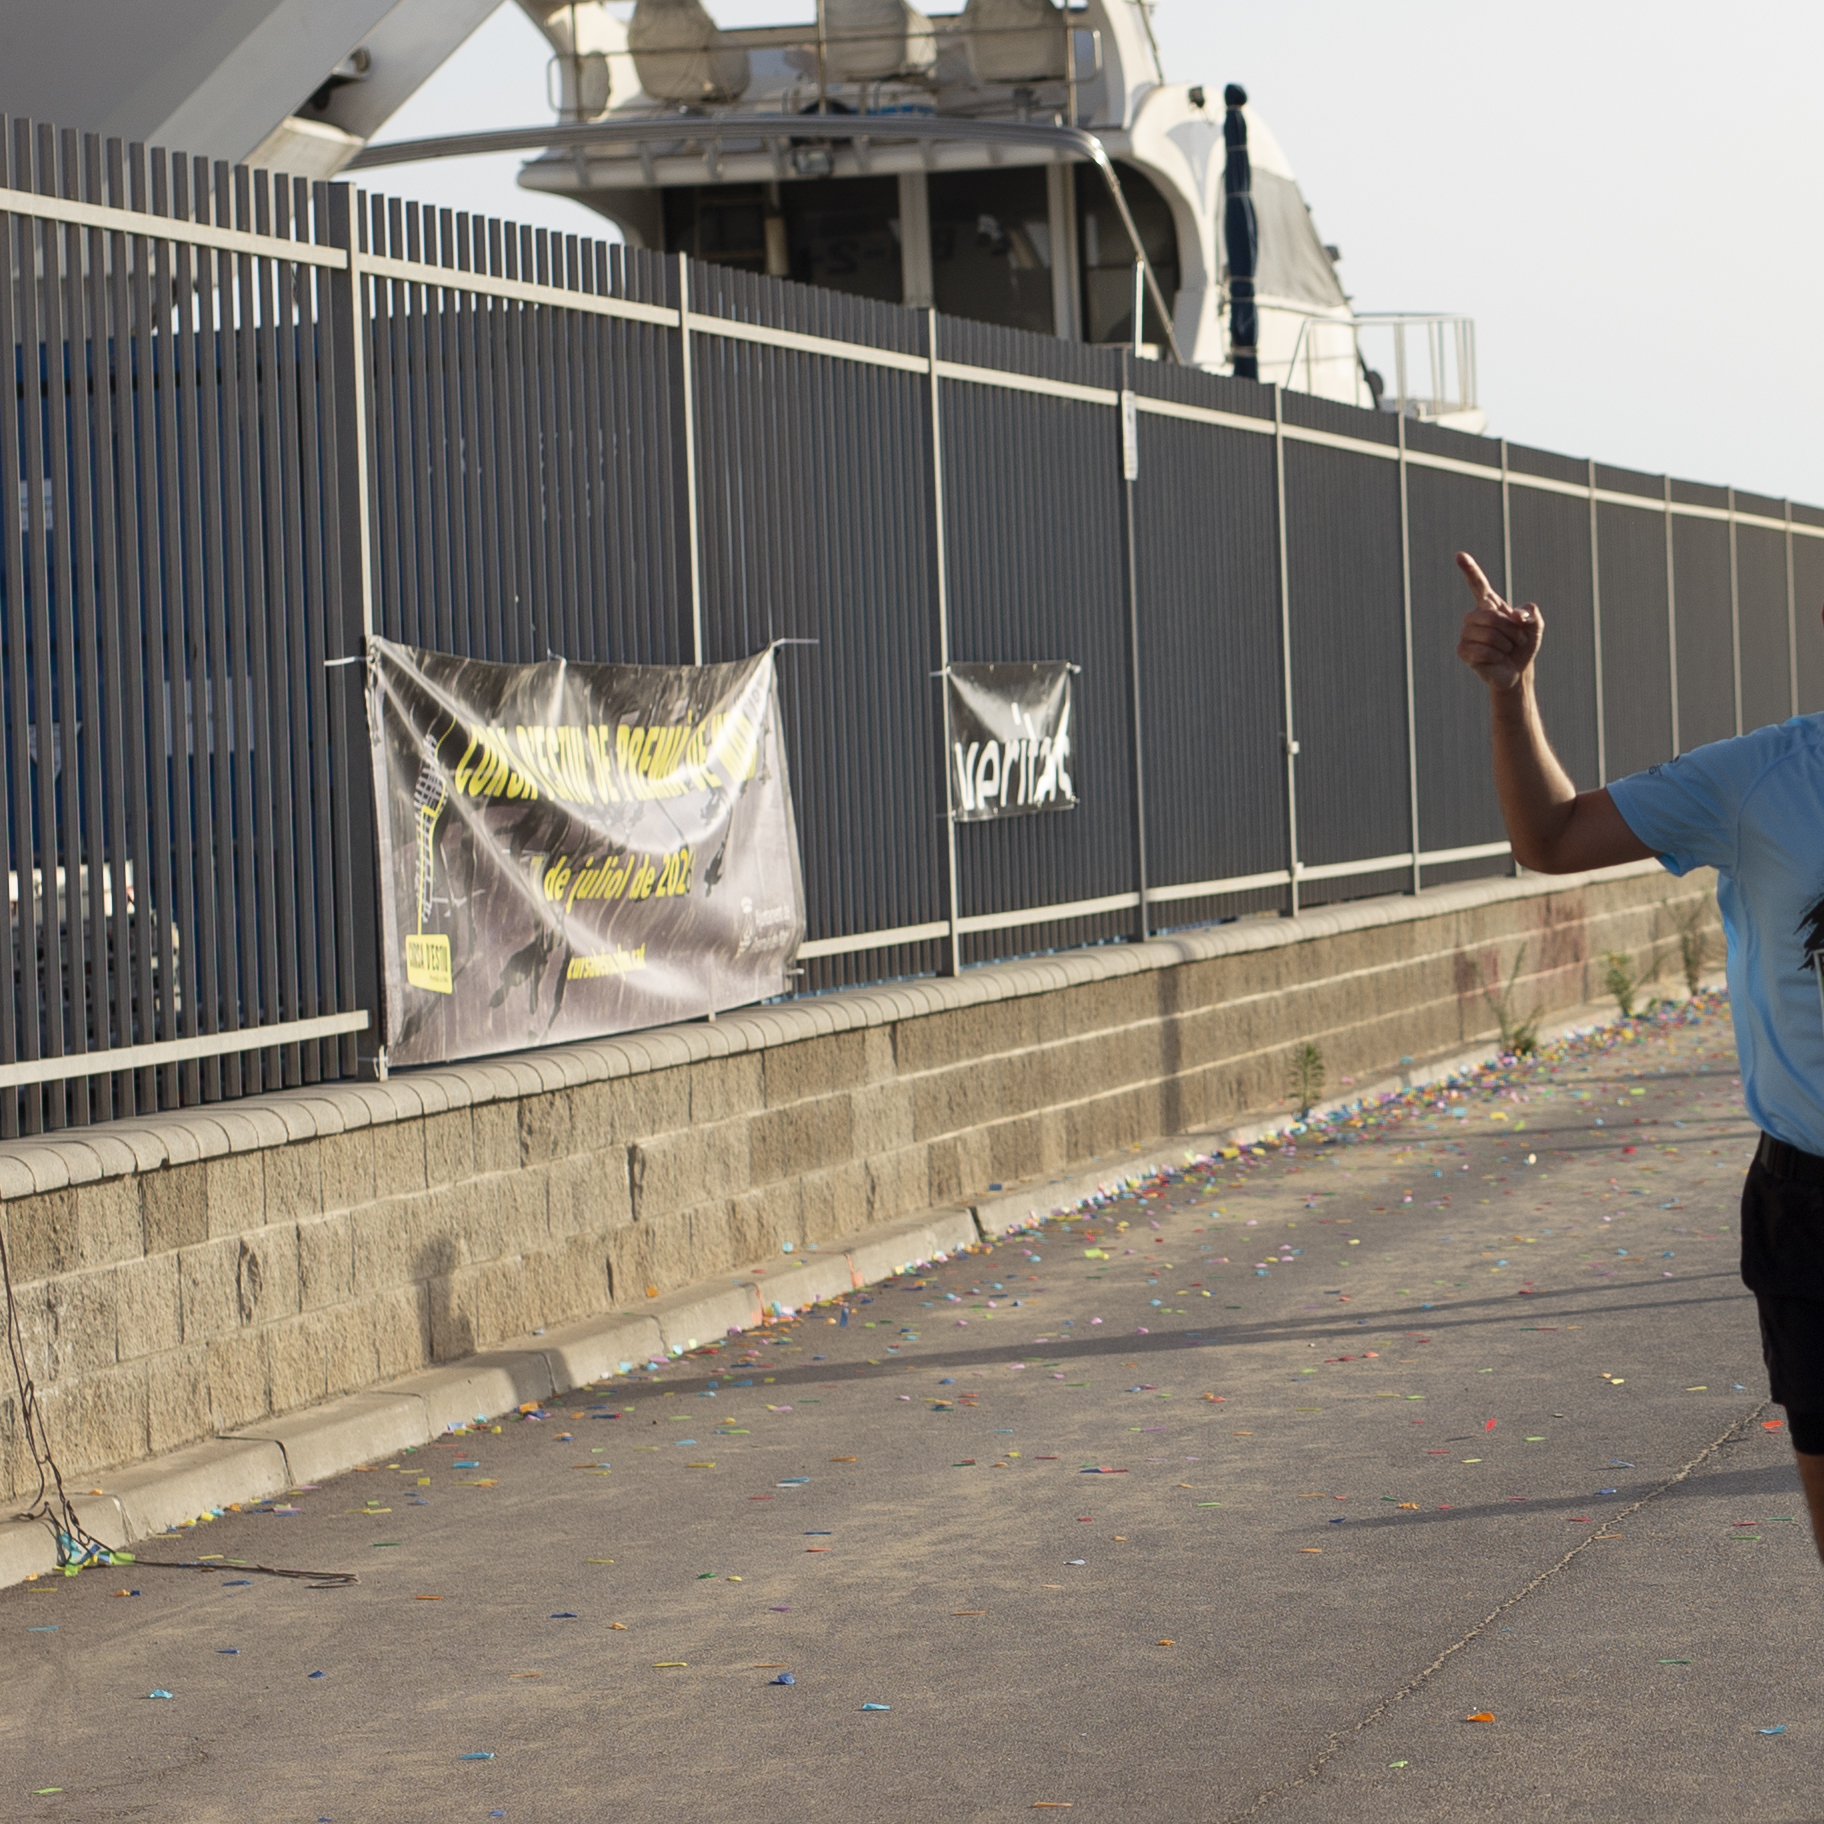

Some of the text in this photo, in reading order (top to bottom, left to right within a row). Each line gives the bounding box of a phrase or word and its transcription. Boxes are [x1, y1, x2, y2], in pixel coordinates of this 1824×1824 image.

[588, 724, 621, 804] DE
[544, 855, 571, 901] de
[565, 854, 635, 915] juliol
[629, 853, 656, 899] de
